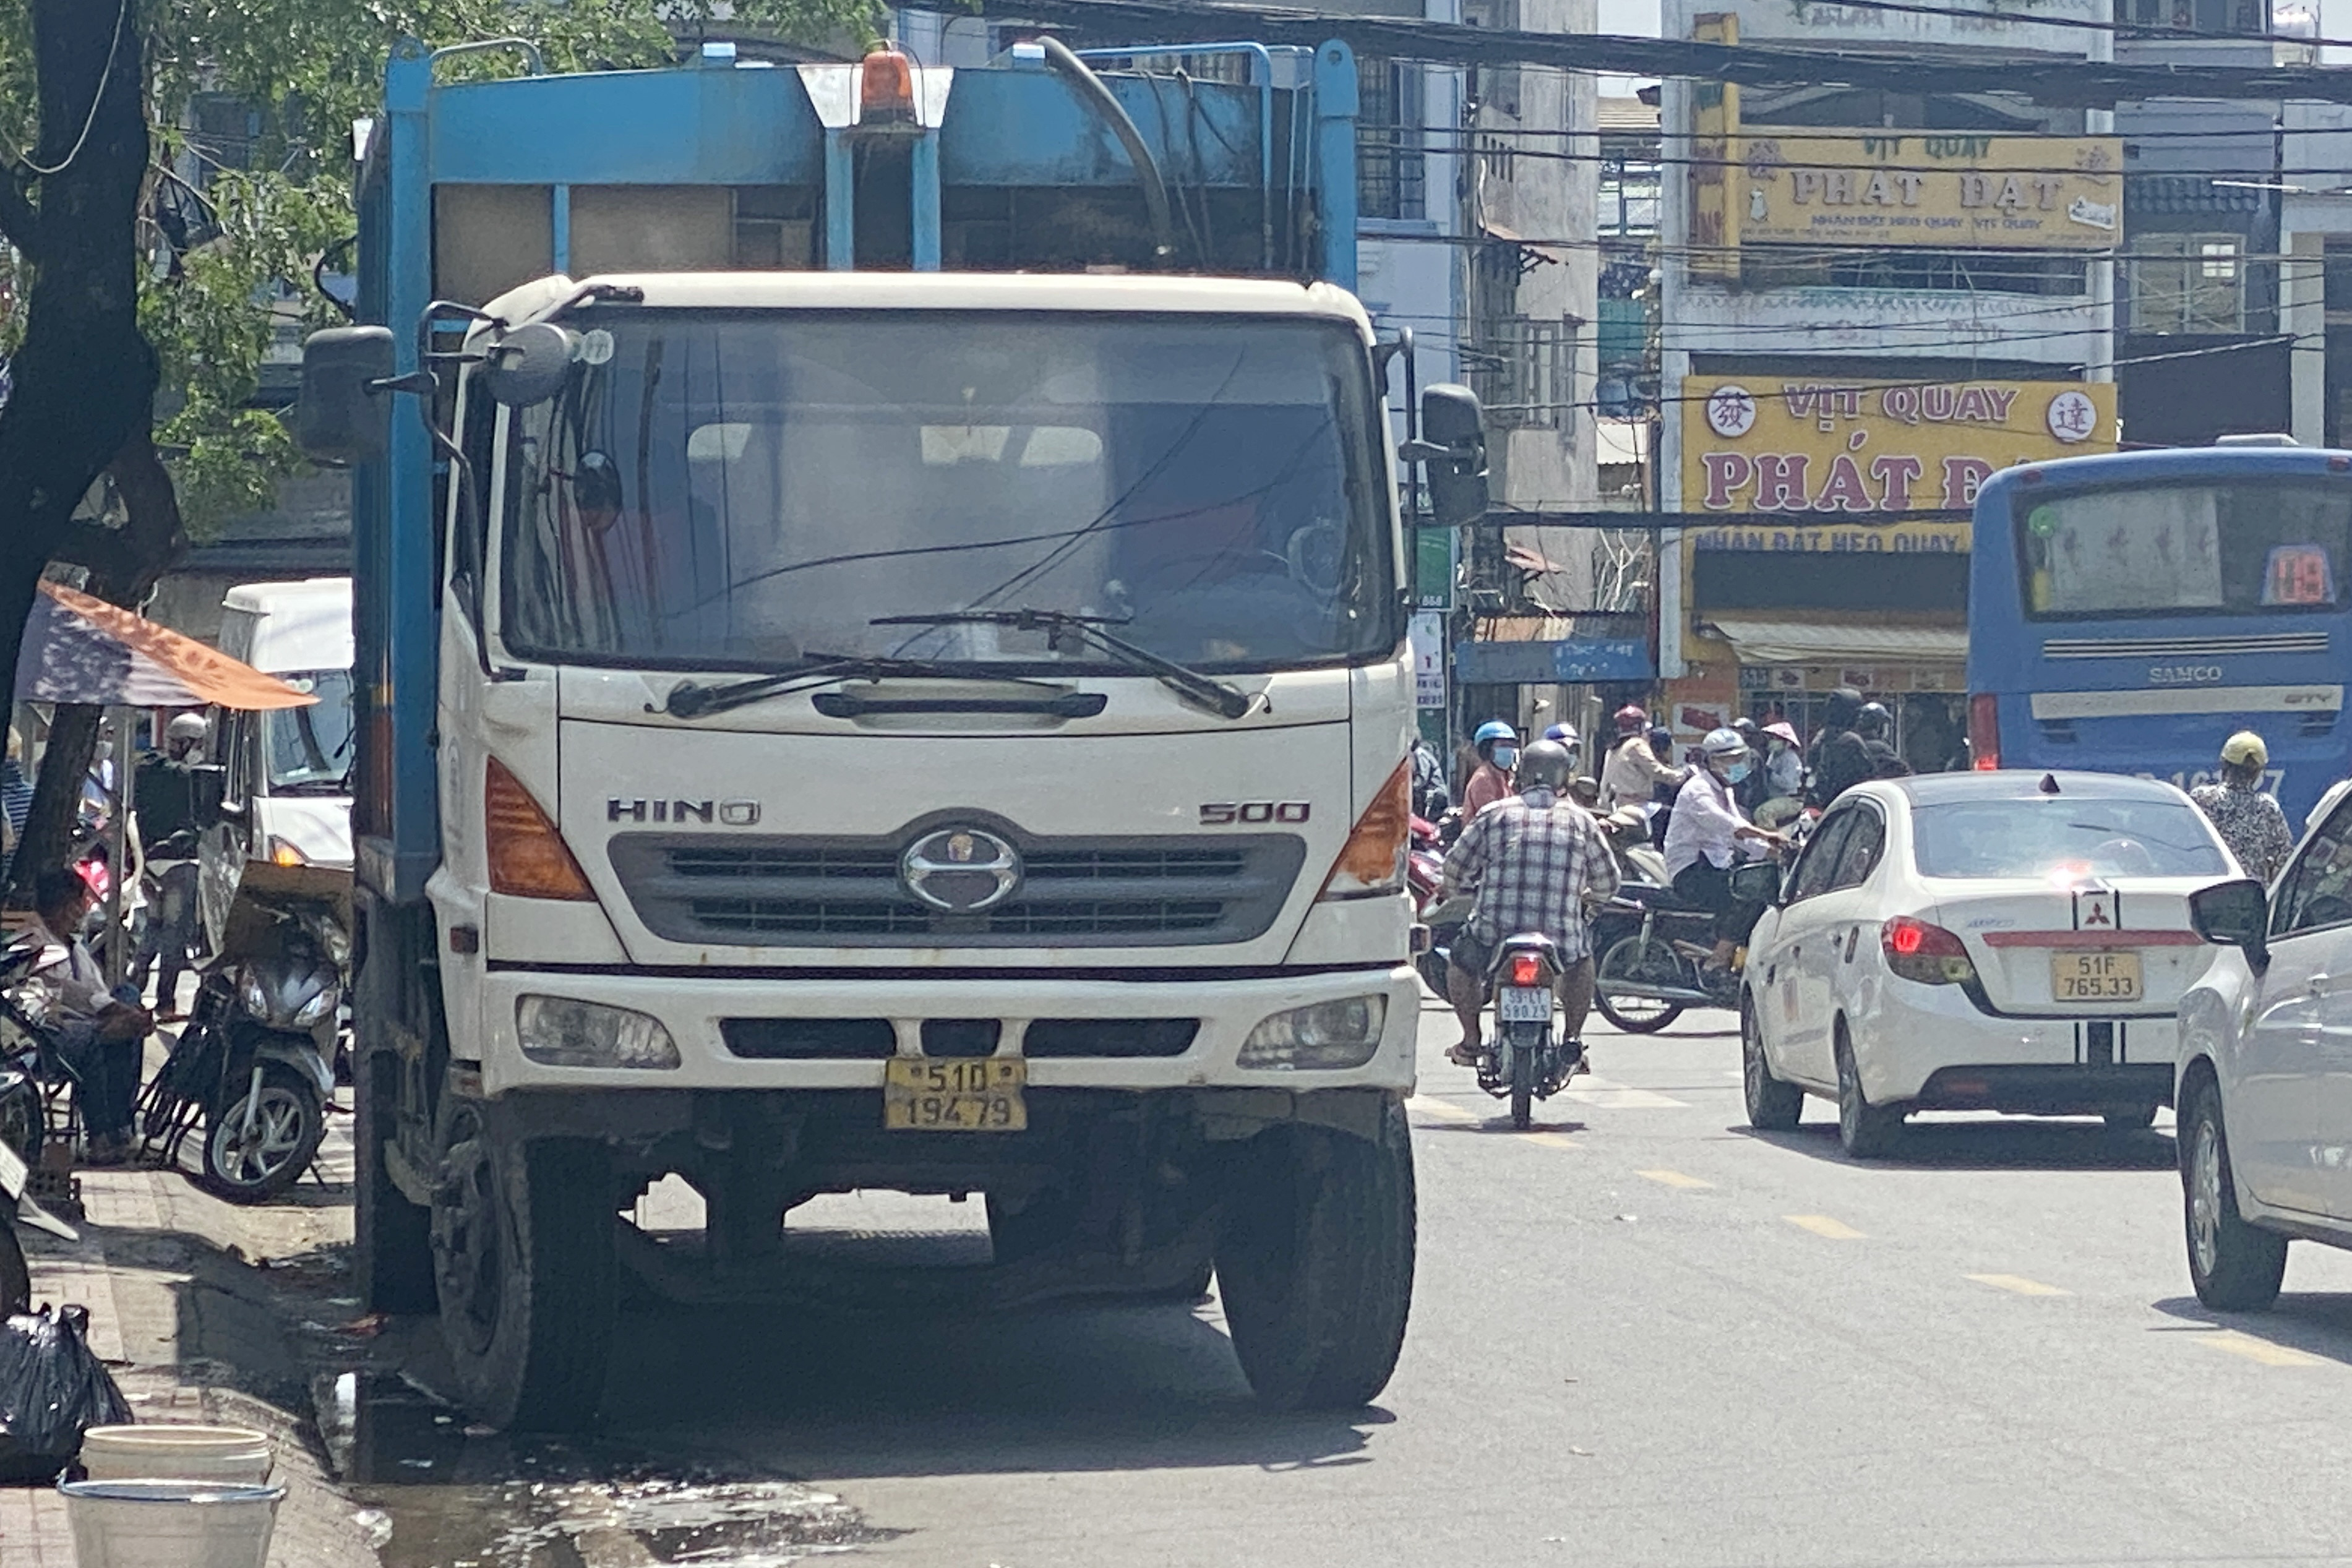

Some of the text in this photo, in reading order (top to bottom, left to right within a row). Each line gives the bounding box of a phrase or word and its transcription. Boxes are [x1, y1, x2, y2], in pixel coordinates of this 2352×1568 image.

[1712, 391, 1752, 429] 發
[1783, 383, 2020, 432] VỊT QUAY
[2054, 397, 2090, 434] 達
[1702, 429, 1923, 512] PHÁT
[2150, 666, 2222, 682] SAMCO
[607, 797, 760, 825] HINO
[1199, 800, 1310, 825] 500
[2079, 956, 2115, 975] 51F
